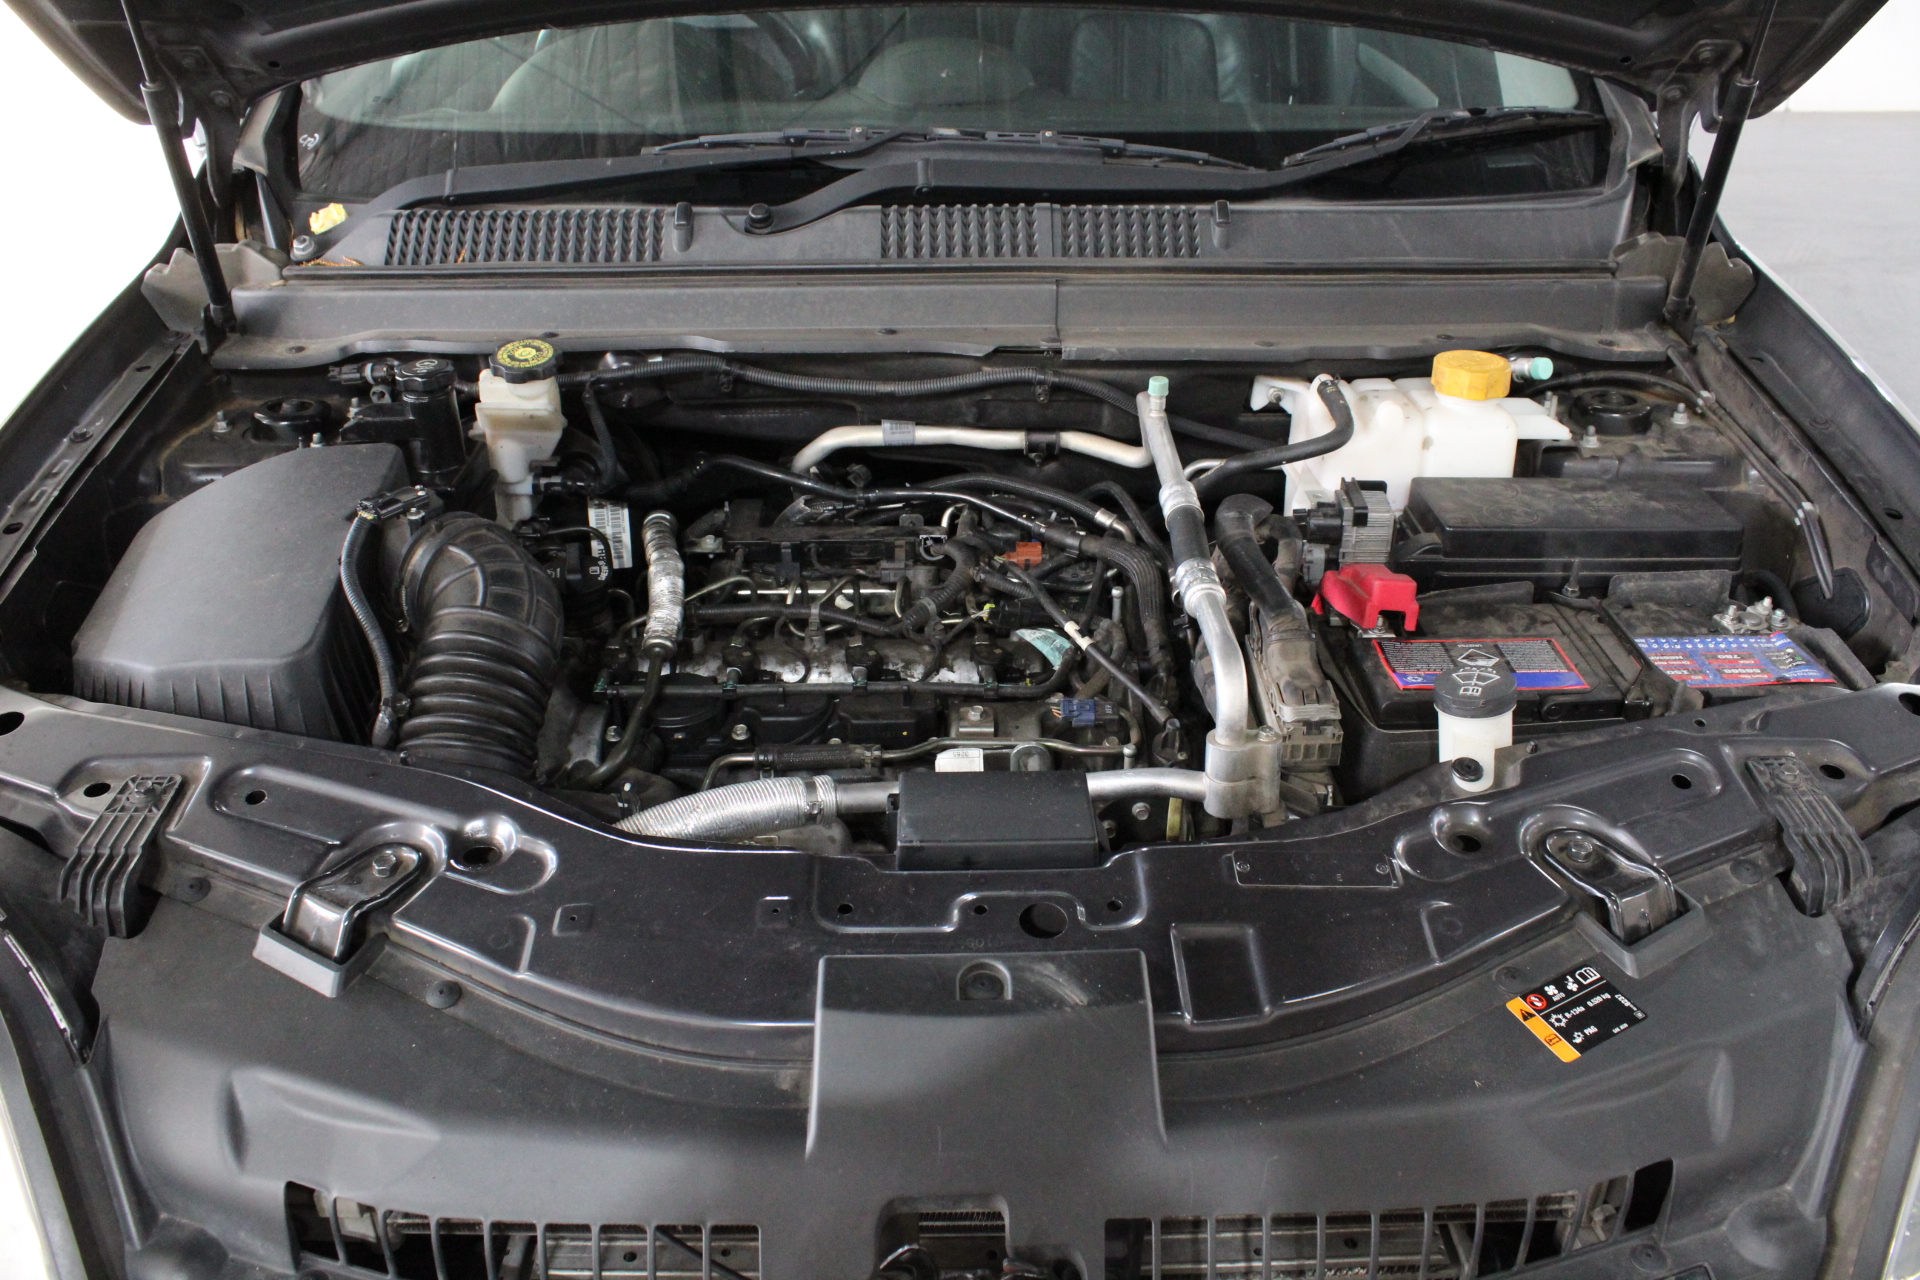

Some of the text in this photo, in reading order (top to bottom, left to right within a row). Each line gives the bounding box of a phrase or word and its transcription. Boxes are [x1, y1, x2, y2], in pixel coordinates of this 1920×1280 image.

[1552, 992, 1566, 1002] AUTO
[1564, 1006, 1586, 1019] R-134a
[1583, 1025, 1599, 1036] PAG
